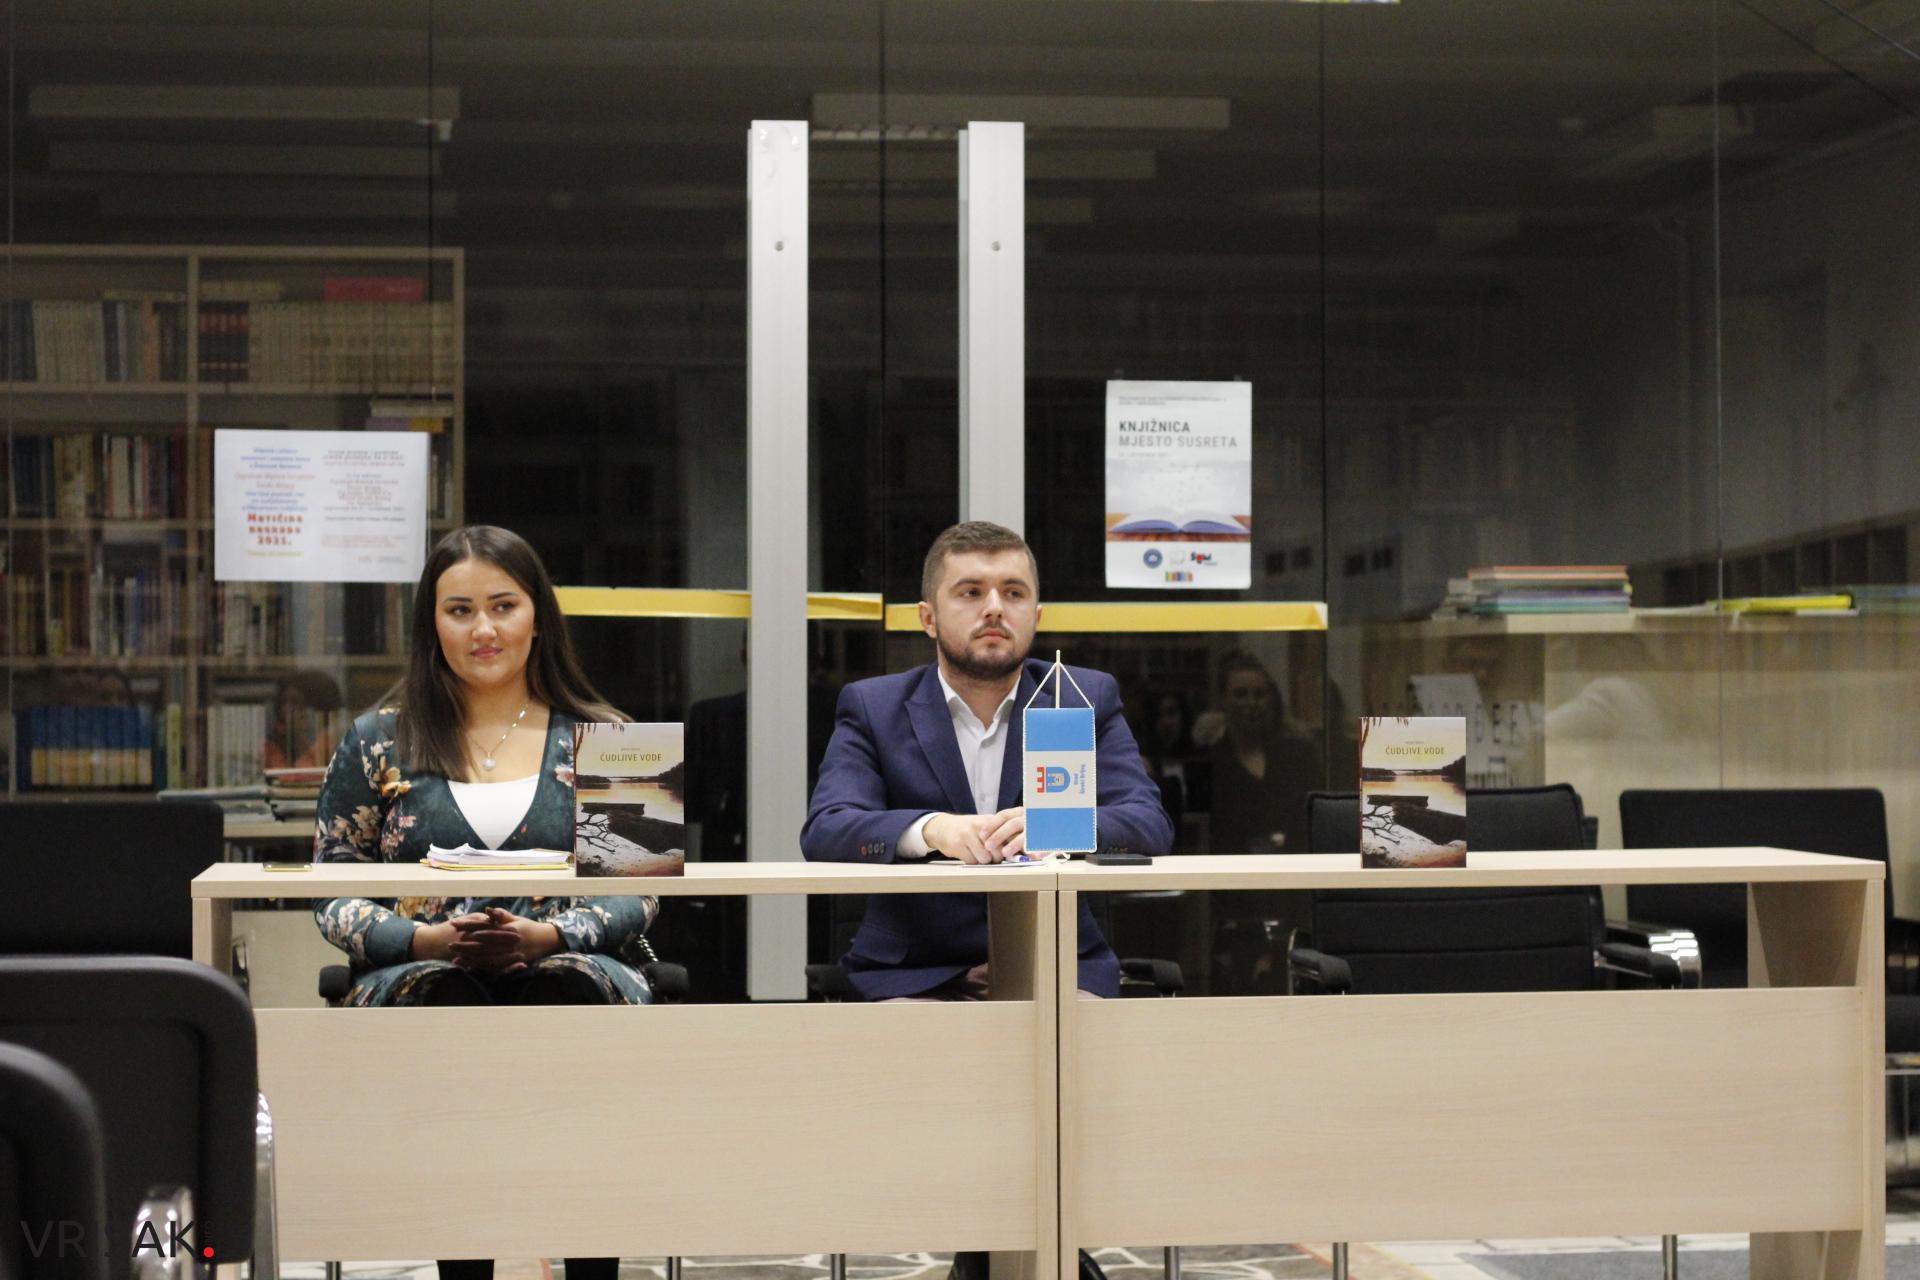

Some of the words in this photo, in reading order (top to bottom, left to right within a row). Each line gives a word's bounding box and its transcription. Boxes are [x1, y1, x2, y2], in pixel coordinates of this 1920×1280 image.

[1119, 418, 1191, 433] KNJIŽNICA
[1119, 435, 1173, 448] MJESTO
[1177, 435, 1237, 448] SUSRETA
[600, 751, 638, 762] ČUDLJIVE
[639, 753, 663, 762] VODE
[1423, 746, 1445, 755] VODE
